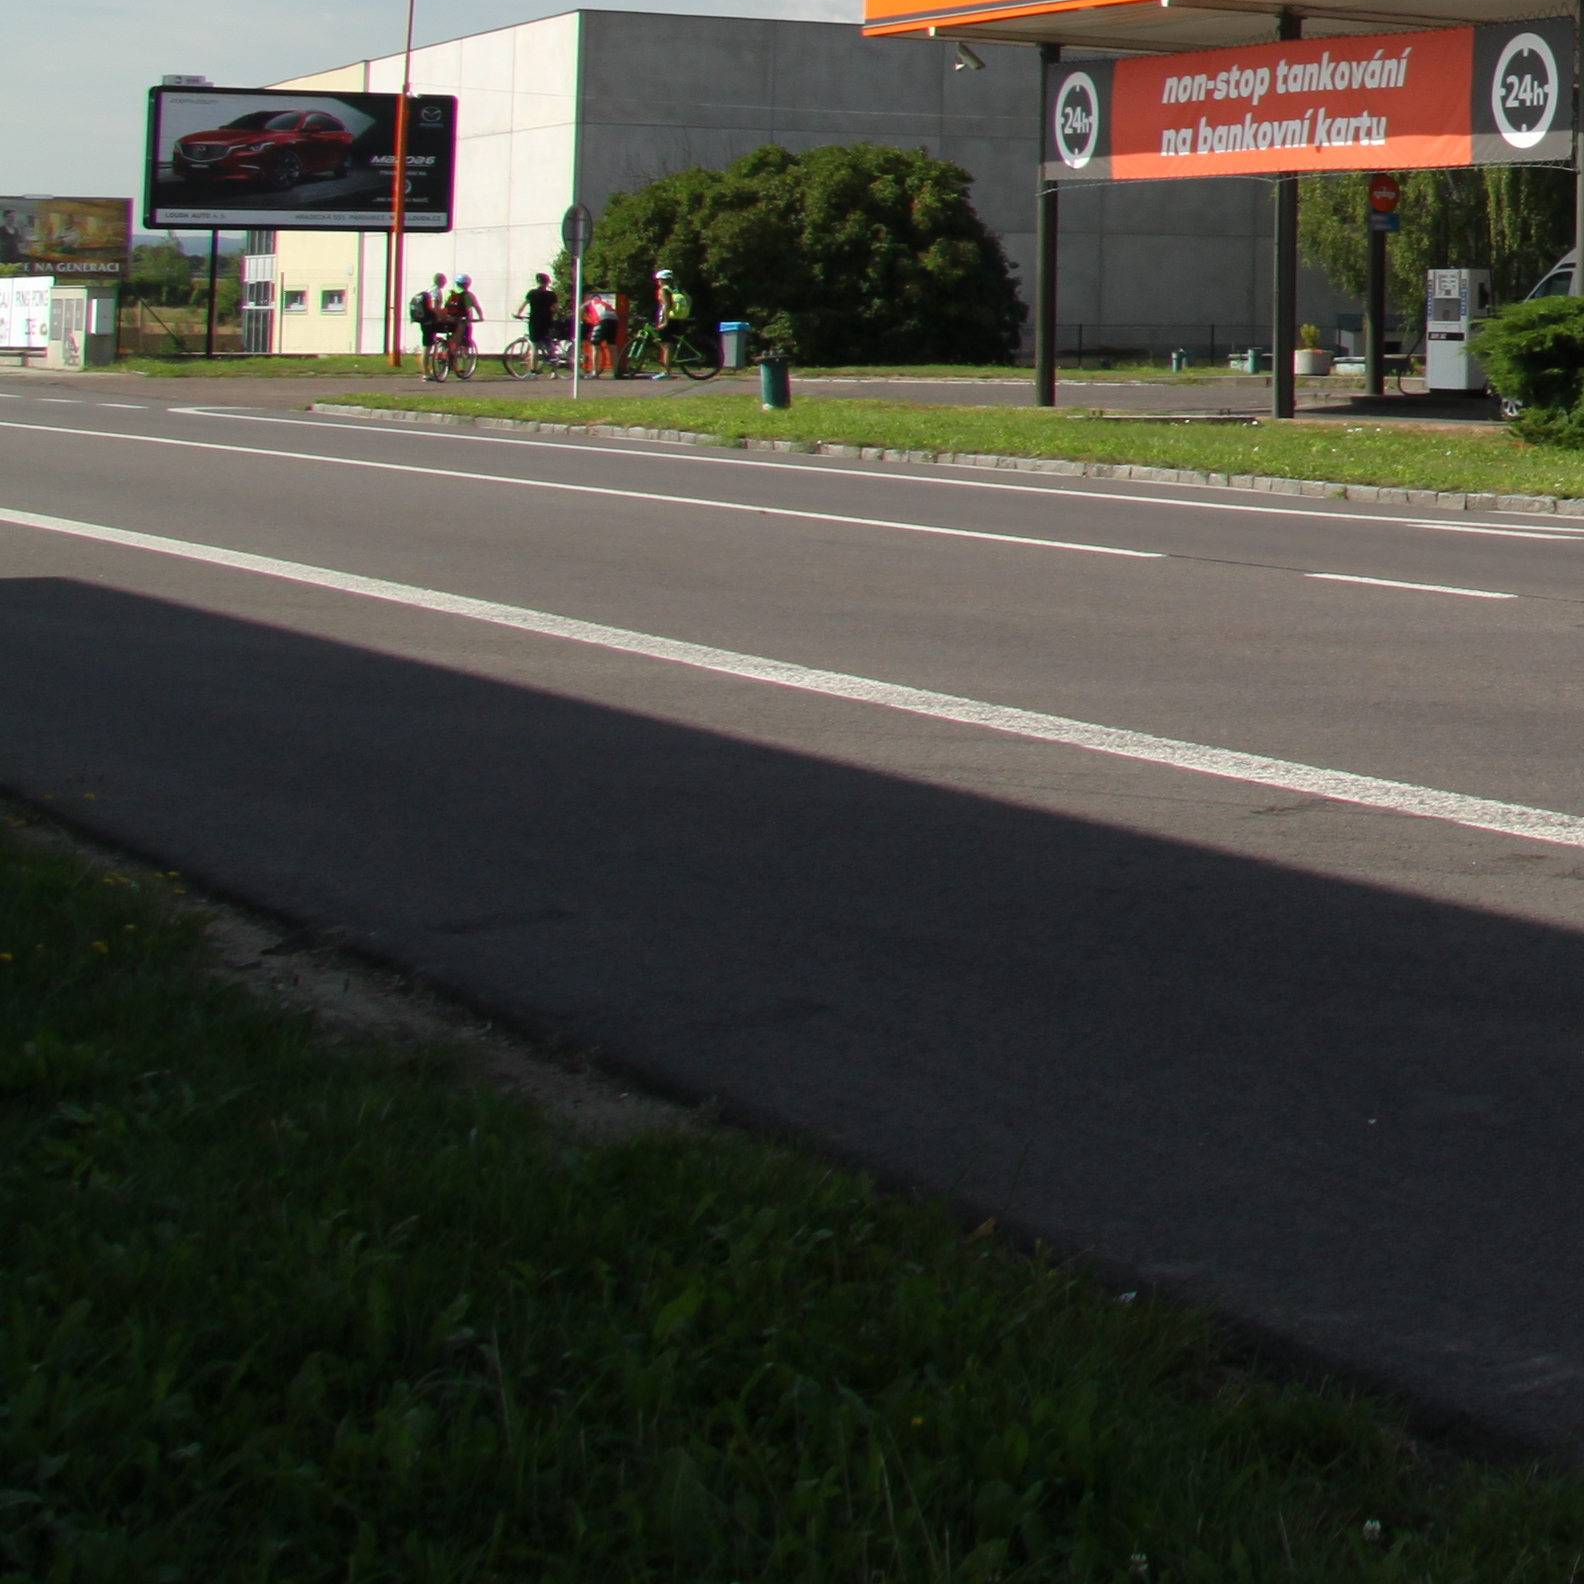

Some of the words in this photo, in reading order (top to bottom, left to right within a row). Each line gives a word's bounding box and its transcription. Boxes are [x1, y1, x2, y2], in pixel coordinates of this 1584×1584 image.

[1161, 63, 1271, 106] non-stop
[1275, 46, 1413, 95] tankování
[1504, 73, 1545, 108] 24h
[1063, 106, 1090, 134] 24h
[1160, 127, 1194, 156] na
[1196, 108, 1315, 155] bankovní
[1314, 106, 1388, 147] kartu
[35, 262, 54, 273] NA
[56, 262, 120, 273] GENERACI
